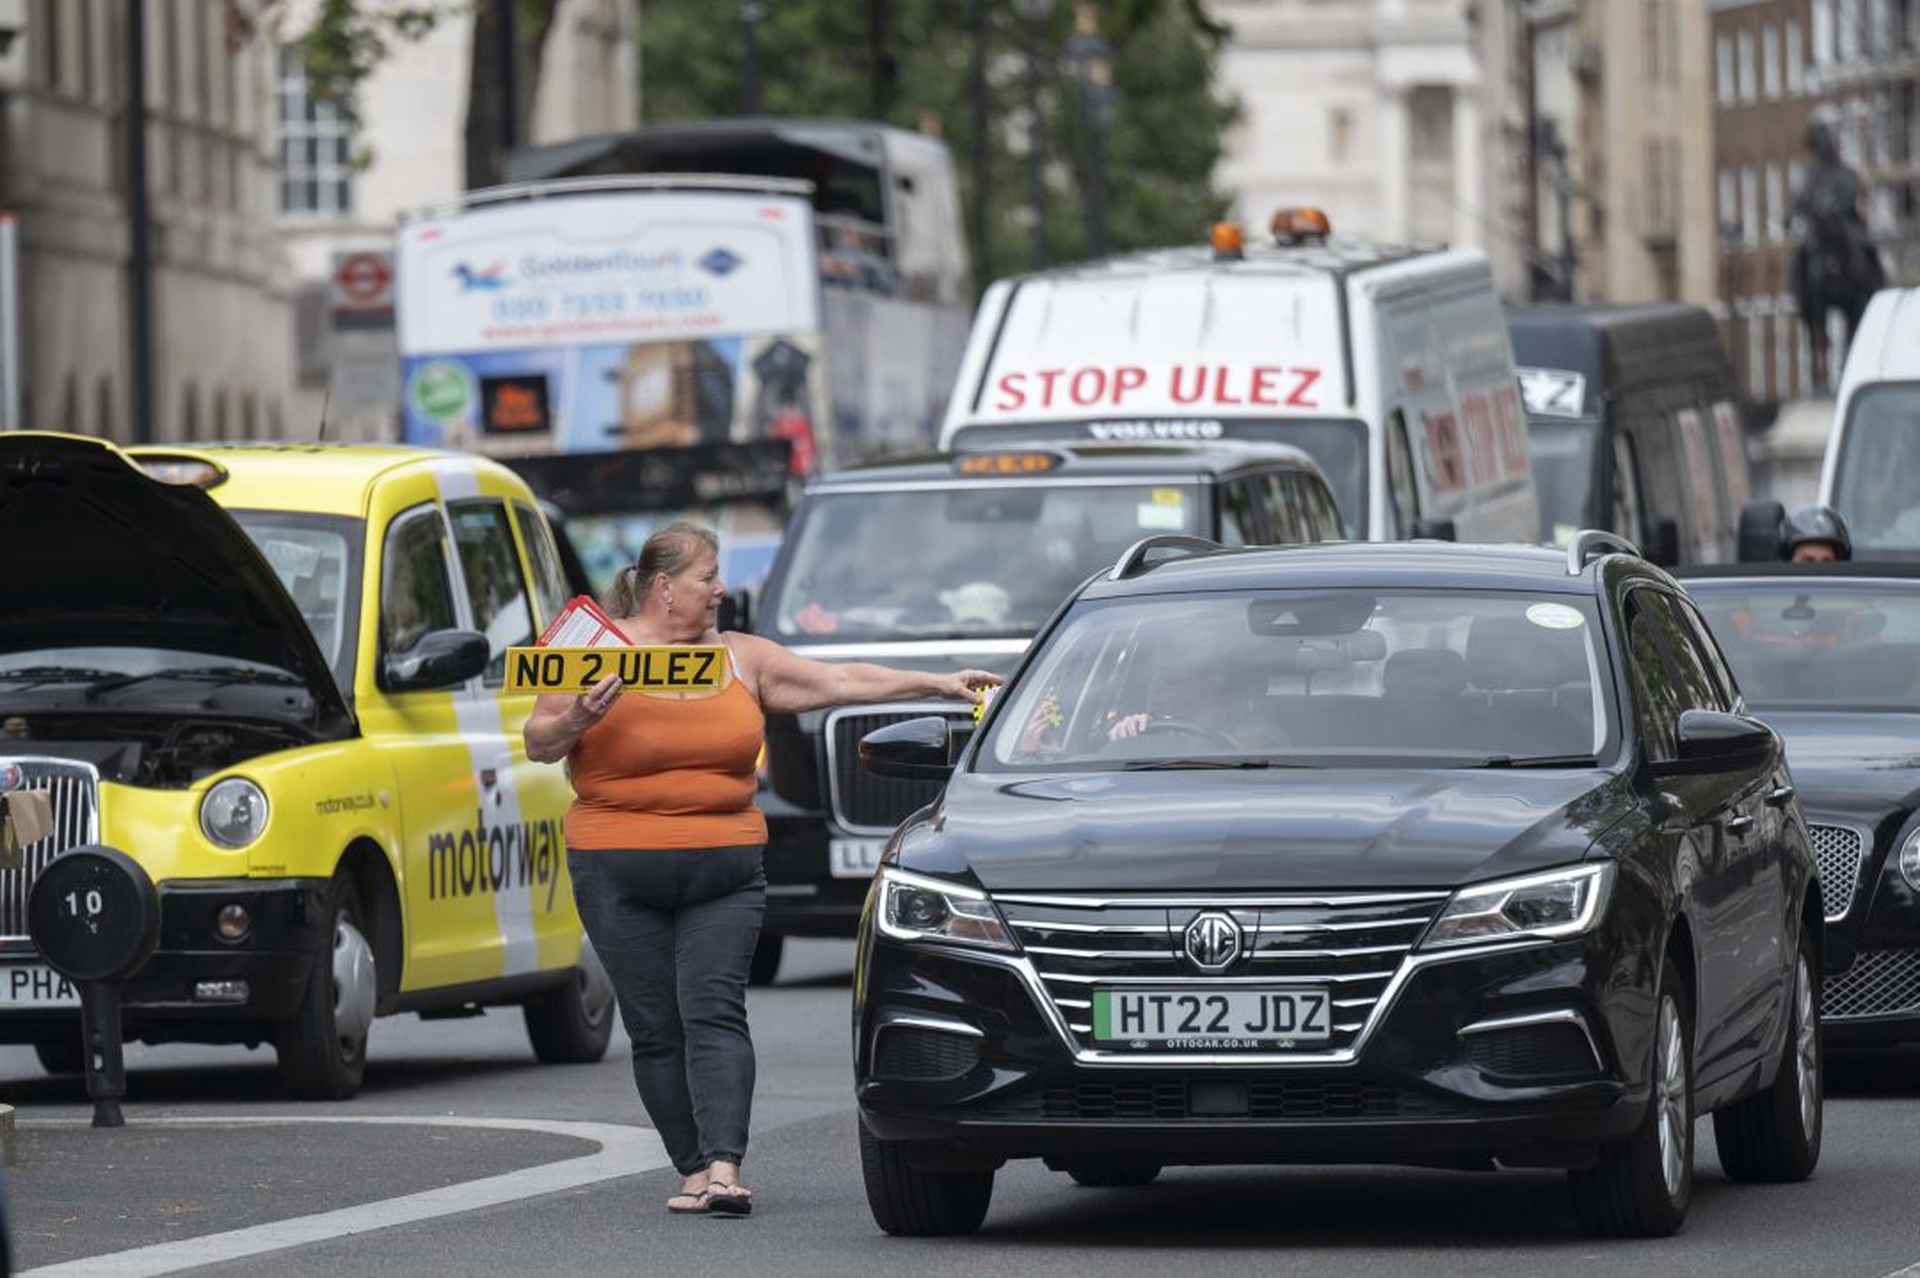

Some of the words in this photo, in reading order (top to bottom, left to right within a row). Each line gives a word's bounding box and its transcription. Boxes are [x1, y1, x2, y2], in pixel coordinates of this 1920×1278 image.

[996, 365, 1148, 411] STOP
[1170, 365, 1323, 408] ULEZ
[515, 653, 564, 687] NO
[579, 653, 604, 686] 2
[617, 652, 716, 686] ULEZ
[428, 807, 559, 912] motorway
[65, 890, 102, 916] 10
[1190, 918, 1234, 964] MG
[10, 969, 73, 1000] PHA
[1120, 995, 1230, 1033] HT22
[1245, 995, 1325, 1033] JDZ
[1167, 1039, 1259, 1048] OTTOCAR.CO.UK
